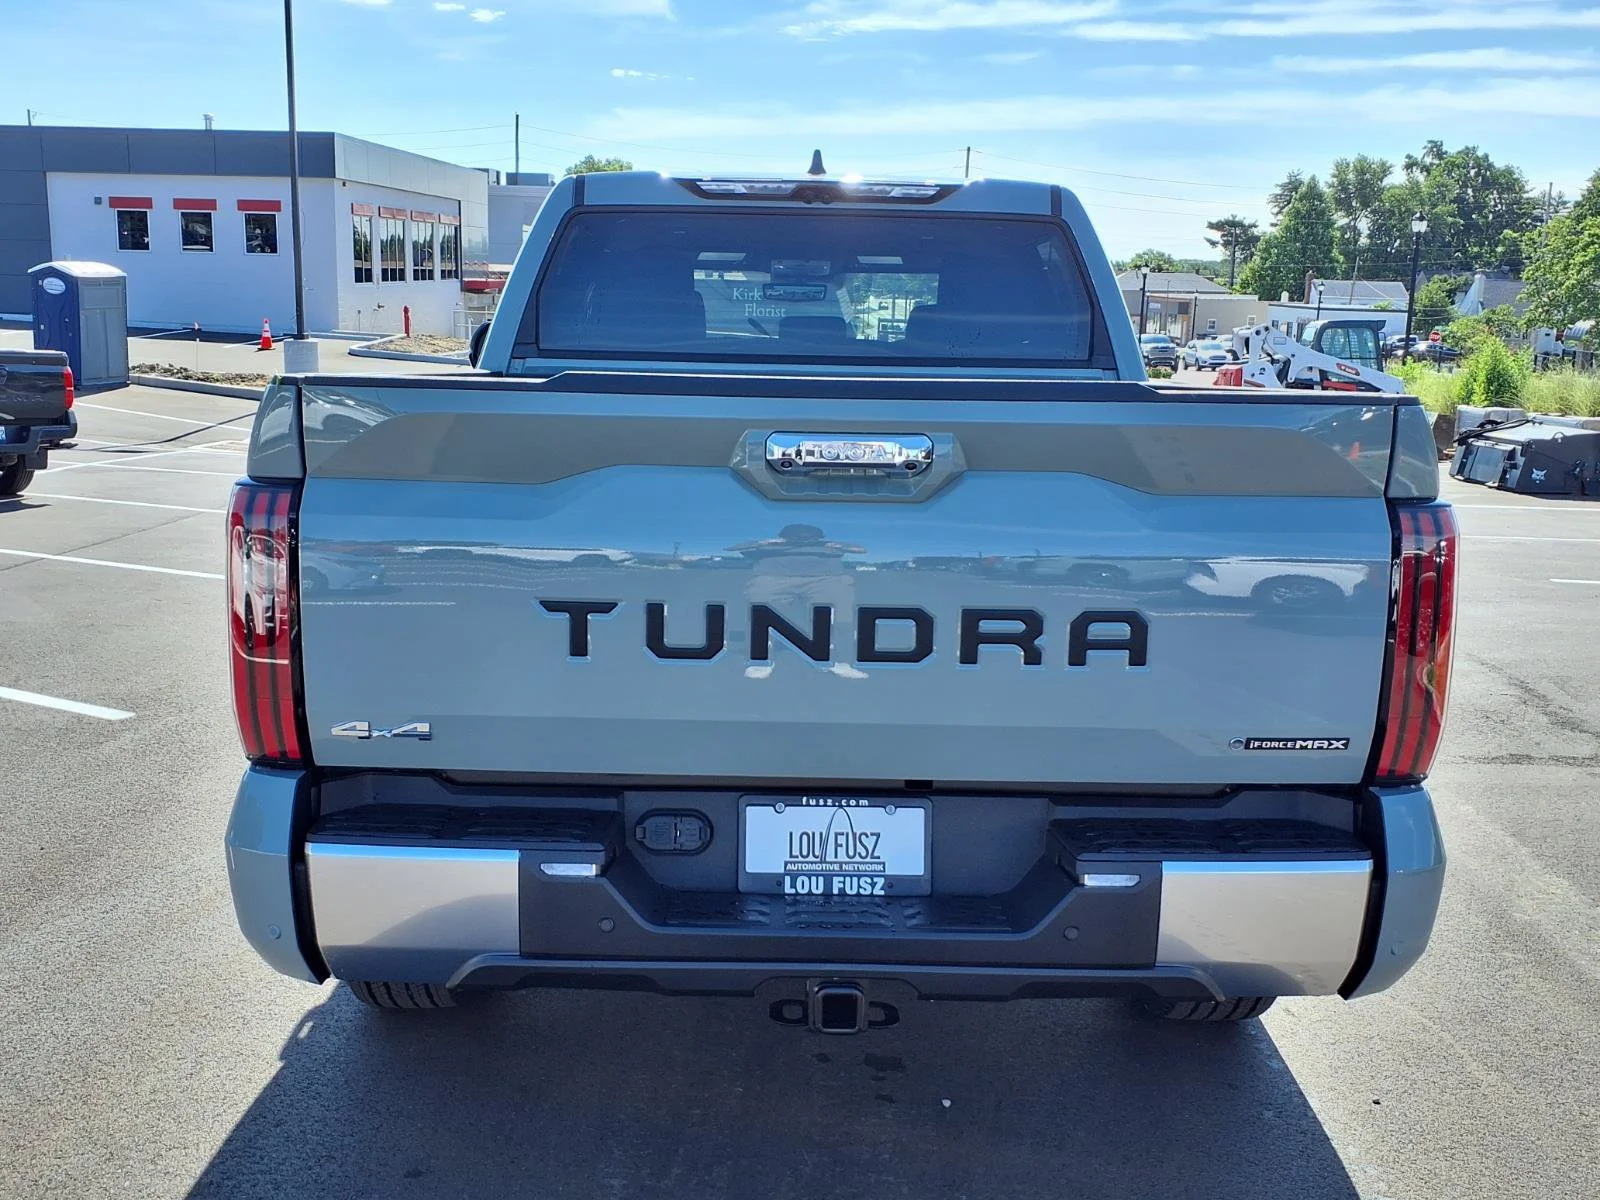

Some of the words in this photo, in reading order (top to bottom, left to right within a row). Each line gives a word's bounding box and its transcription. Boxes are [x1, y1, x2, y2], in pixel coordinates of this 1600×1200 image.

[744, 302, 787, 318] Florist
[812, 445, 889, 461] TOYOTA
[538, 600, 1151, 669] TUNDRA
[801, 796, 869, 806] fusz.com
[788, 831, 824, 859] LOU
[833, 831, 881, 860] FUSZ
[786, 862, 840, 871] AUTOMOTIVE
[842, 863, 884, 872] NETWORK
[784, 875, 824, 895] LOU
[832, 876, 885, 896] FUSZ
